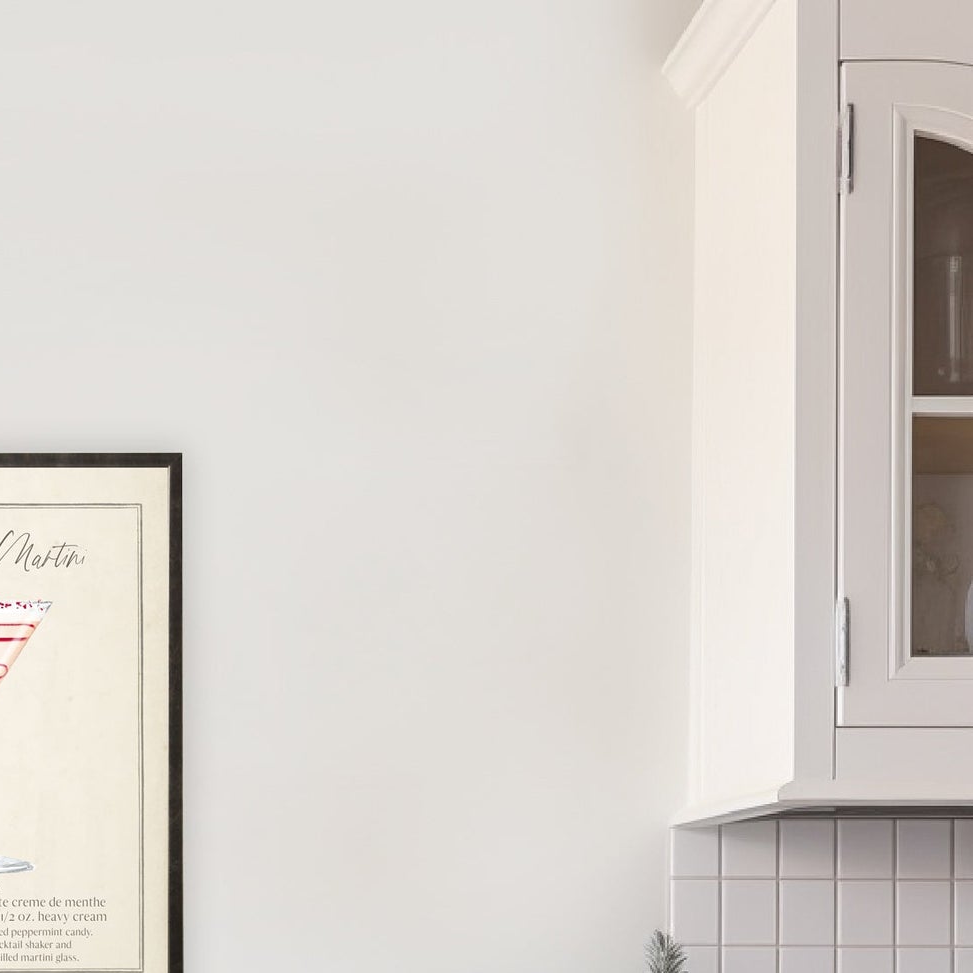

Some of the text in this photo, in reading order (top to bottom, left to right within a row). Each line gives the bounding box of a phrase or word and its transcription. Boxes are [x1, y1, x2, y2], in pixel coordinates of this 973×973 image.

[12, 899, 46, 907] creme
[49, 897, 61, 907] de
[65, 897, 106, 907] menthe
[0, 911, 15, 922] 1/2
[38, 911, 69, 924] heavy
[11, 928, 62, 938] peppermint
[66, 928, 93, 938] candy.
[25, 940, 53, 949] shaker
[56, 940, 71, 948] and
[55, 953, 79, 963] glass.
